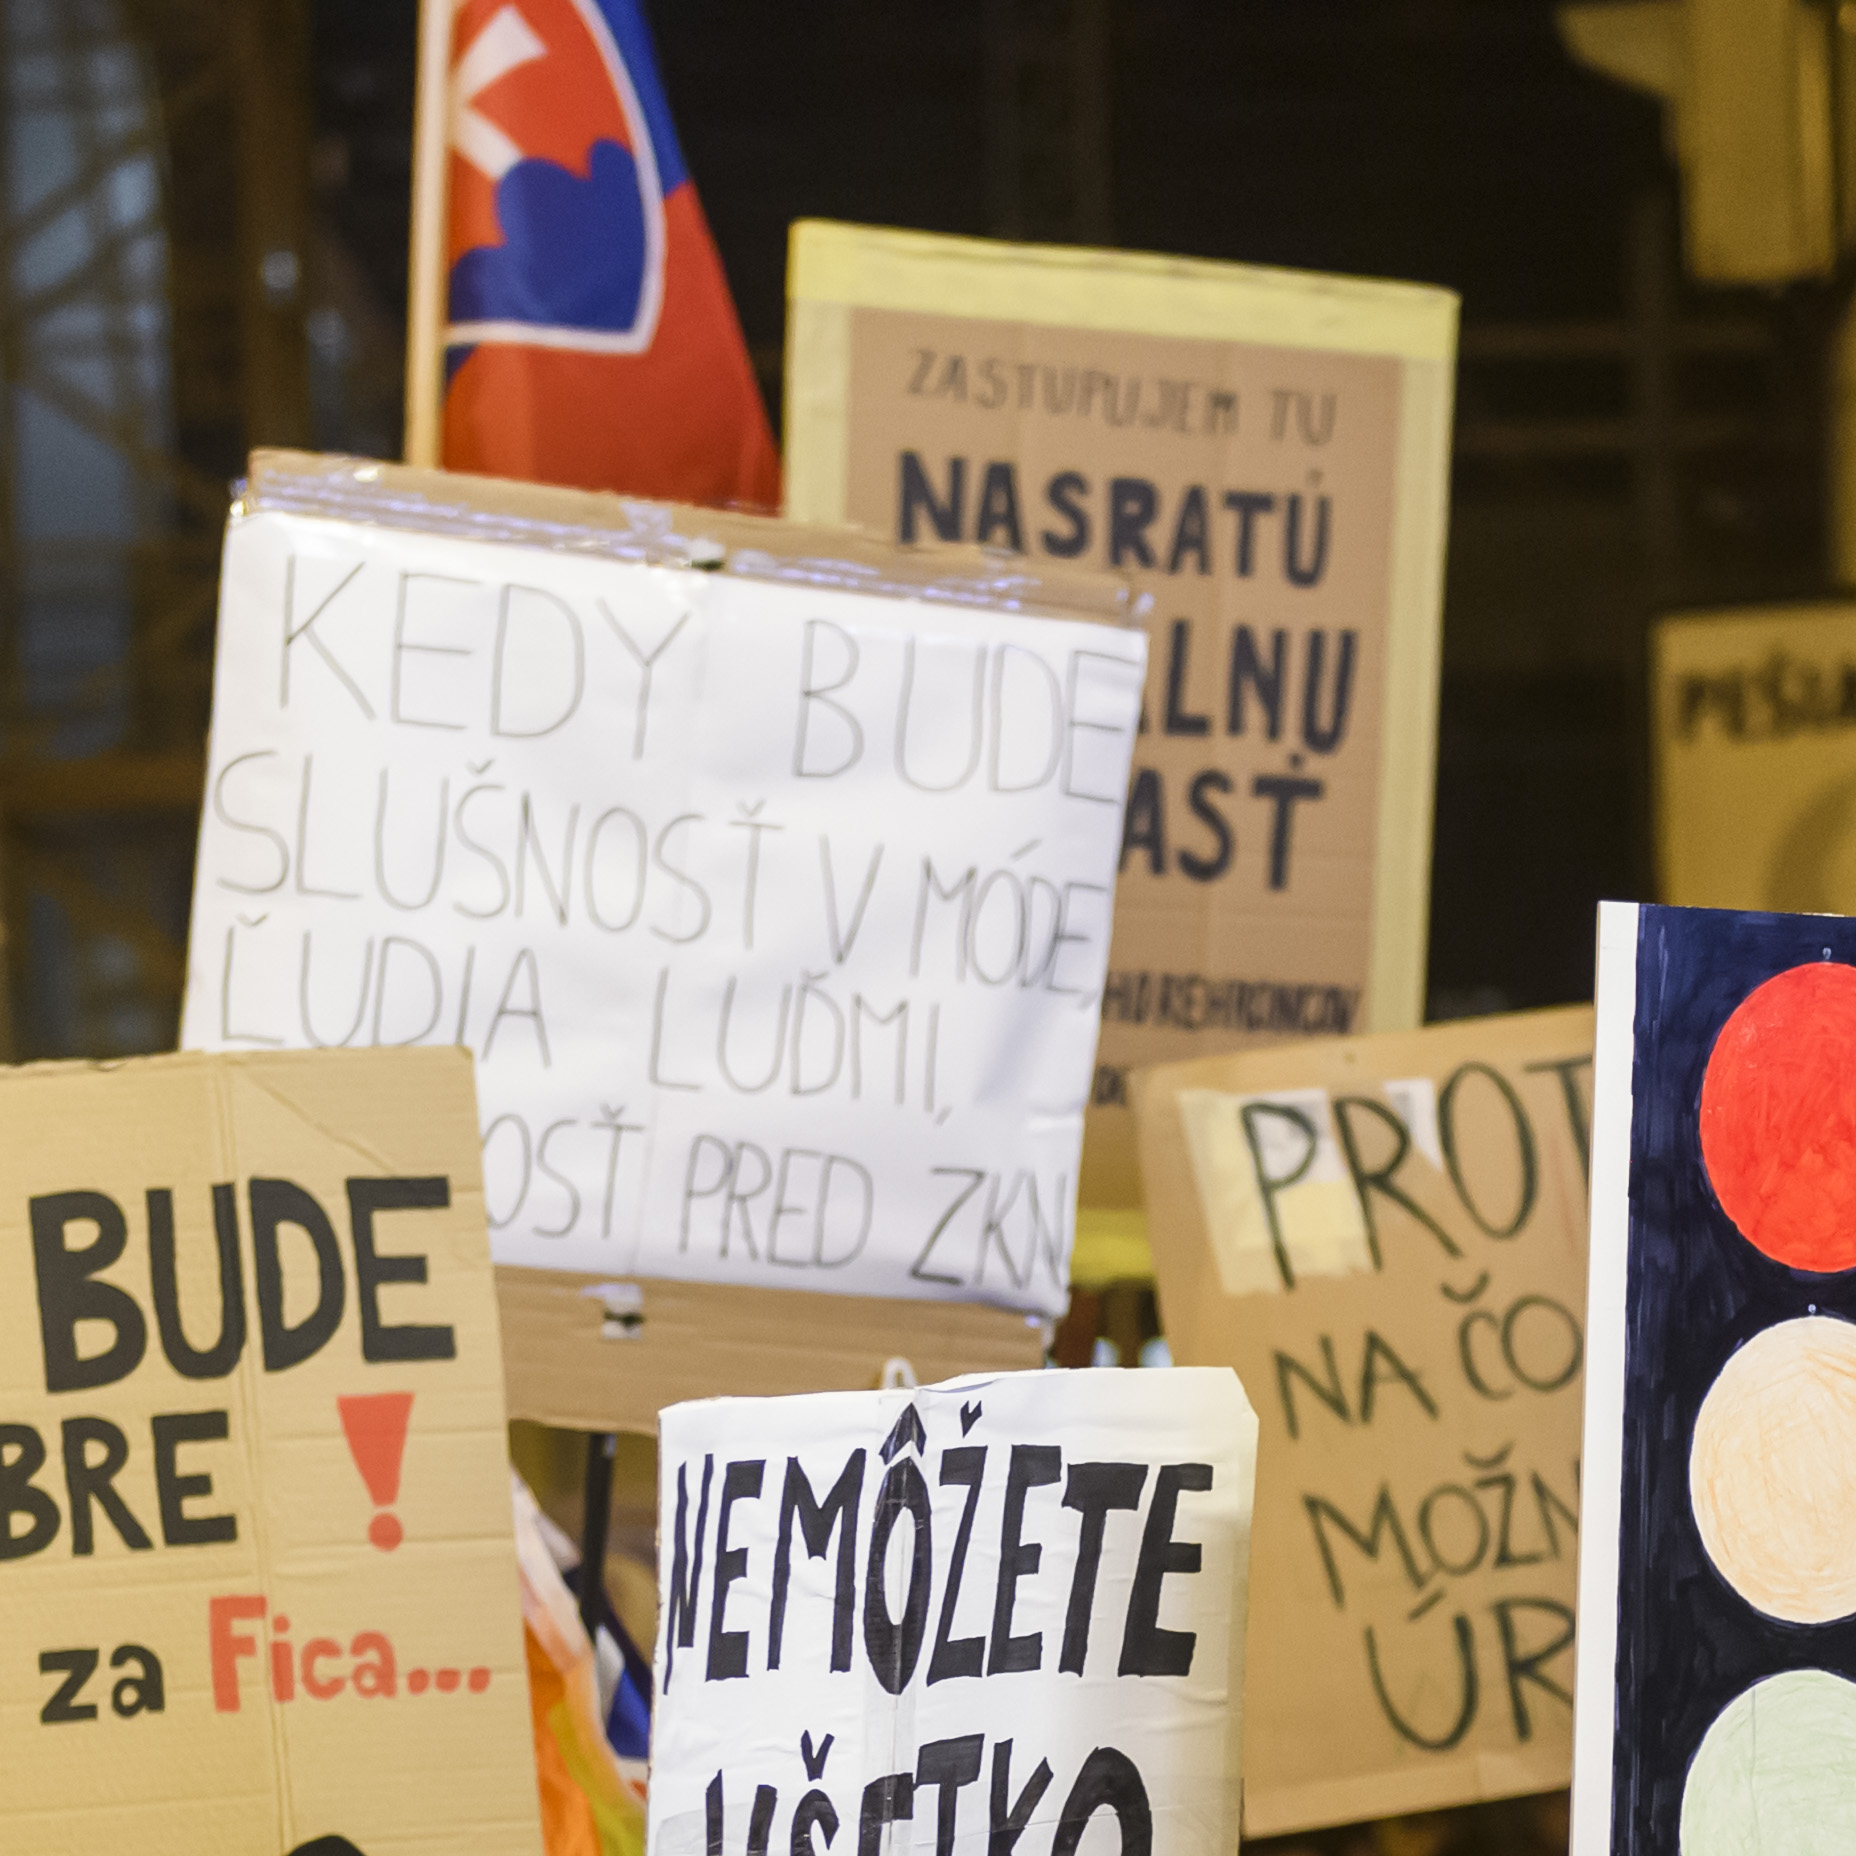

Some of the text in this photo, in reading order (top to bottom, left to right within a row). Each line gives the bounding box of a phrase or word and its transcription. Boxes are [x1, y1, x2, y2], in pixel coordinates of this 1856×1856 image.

[907, 348, 1240, 436] ZASTUPUJEM
[898, 449, 1334, 590] NASRATÚ
[276, 555, 1142, 806] KEDY BUDE
[211, 750, 784, 952] SLUŠNOSŤ
[819, 834, 885, 968] V
[1118, 752, 1325, 893] ASŤ
[219, 912, 552, 1068] ĽUDIA
[482, 1102, 646, 1241] OSŤ
[679, 1130, 875, 1270] PRED
[1240, 1059, 1592, 1293] PROT
[28, 1174, 457, 1394] BUDE
[1271, 1328, 1440, 1441] NA
[1440, 1270, 1584, 1400] ČO
[662, 1400, 1214, 1695] NEMÔŽETE
[1304, 1441, 1579, 1611] MOŽN
[39, 1643, 166, 1725] za
[1365, 1588, 1575, 1752] ÚR
